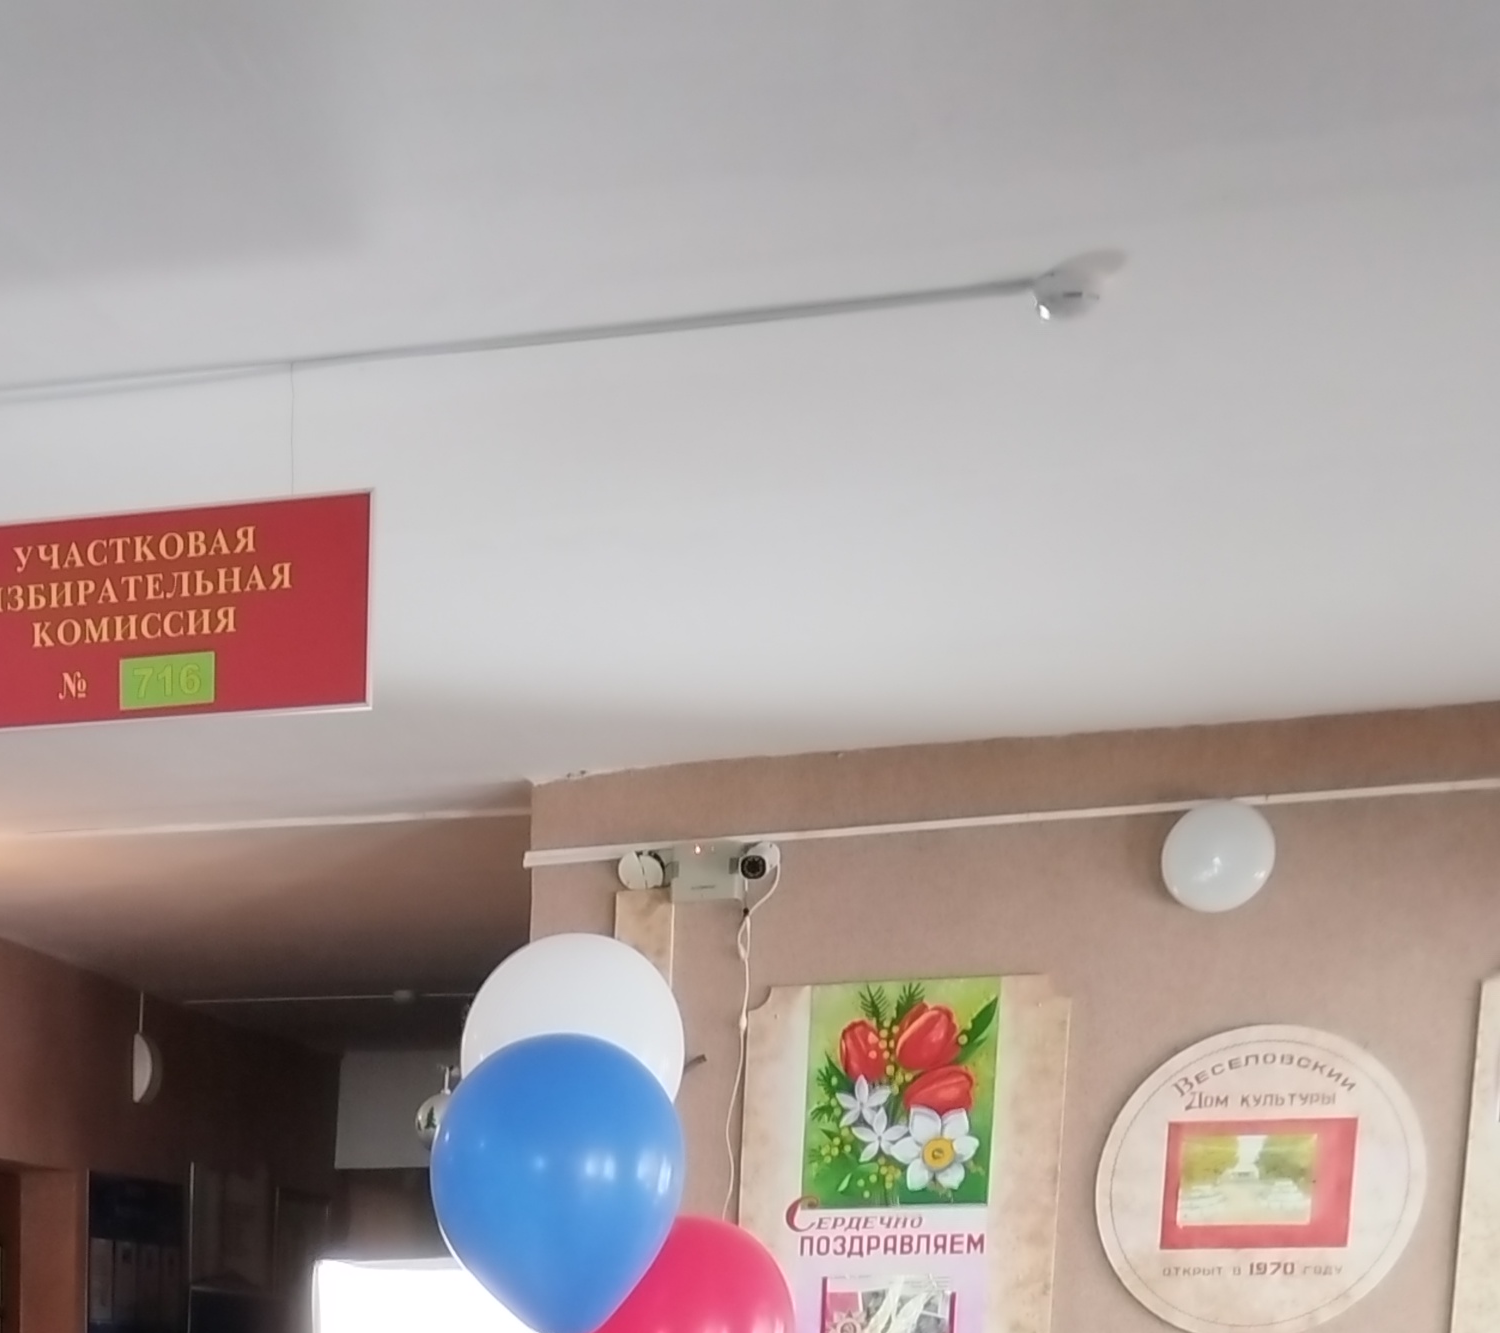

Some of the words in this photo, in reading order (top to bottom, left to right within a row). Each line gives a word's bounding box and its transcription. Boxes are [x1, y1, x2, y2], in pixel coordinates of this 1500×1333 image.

[12, 525, 257, 574] УЧАСТКОВАЯ
[31, 605, 238, 649] КОМИССИЯ
[58, 671, 88, 700] №
[132, 662, 202, 699] 716
[1240, 1092, 1337, 1108] КУЛЬТУРЫ
[799, 1232, 986, 1258] ПОЗДРАВЛЯЕМ
[1249, 1261, 1295, 1276] 1970
